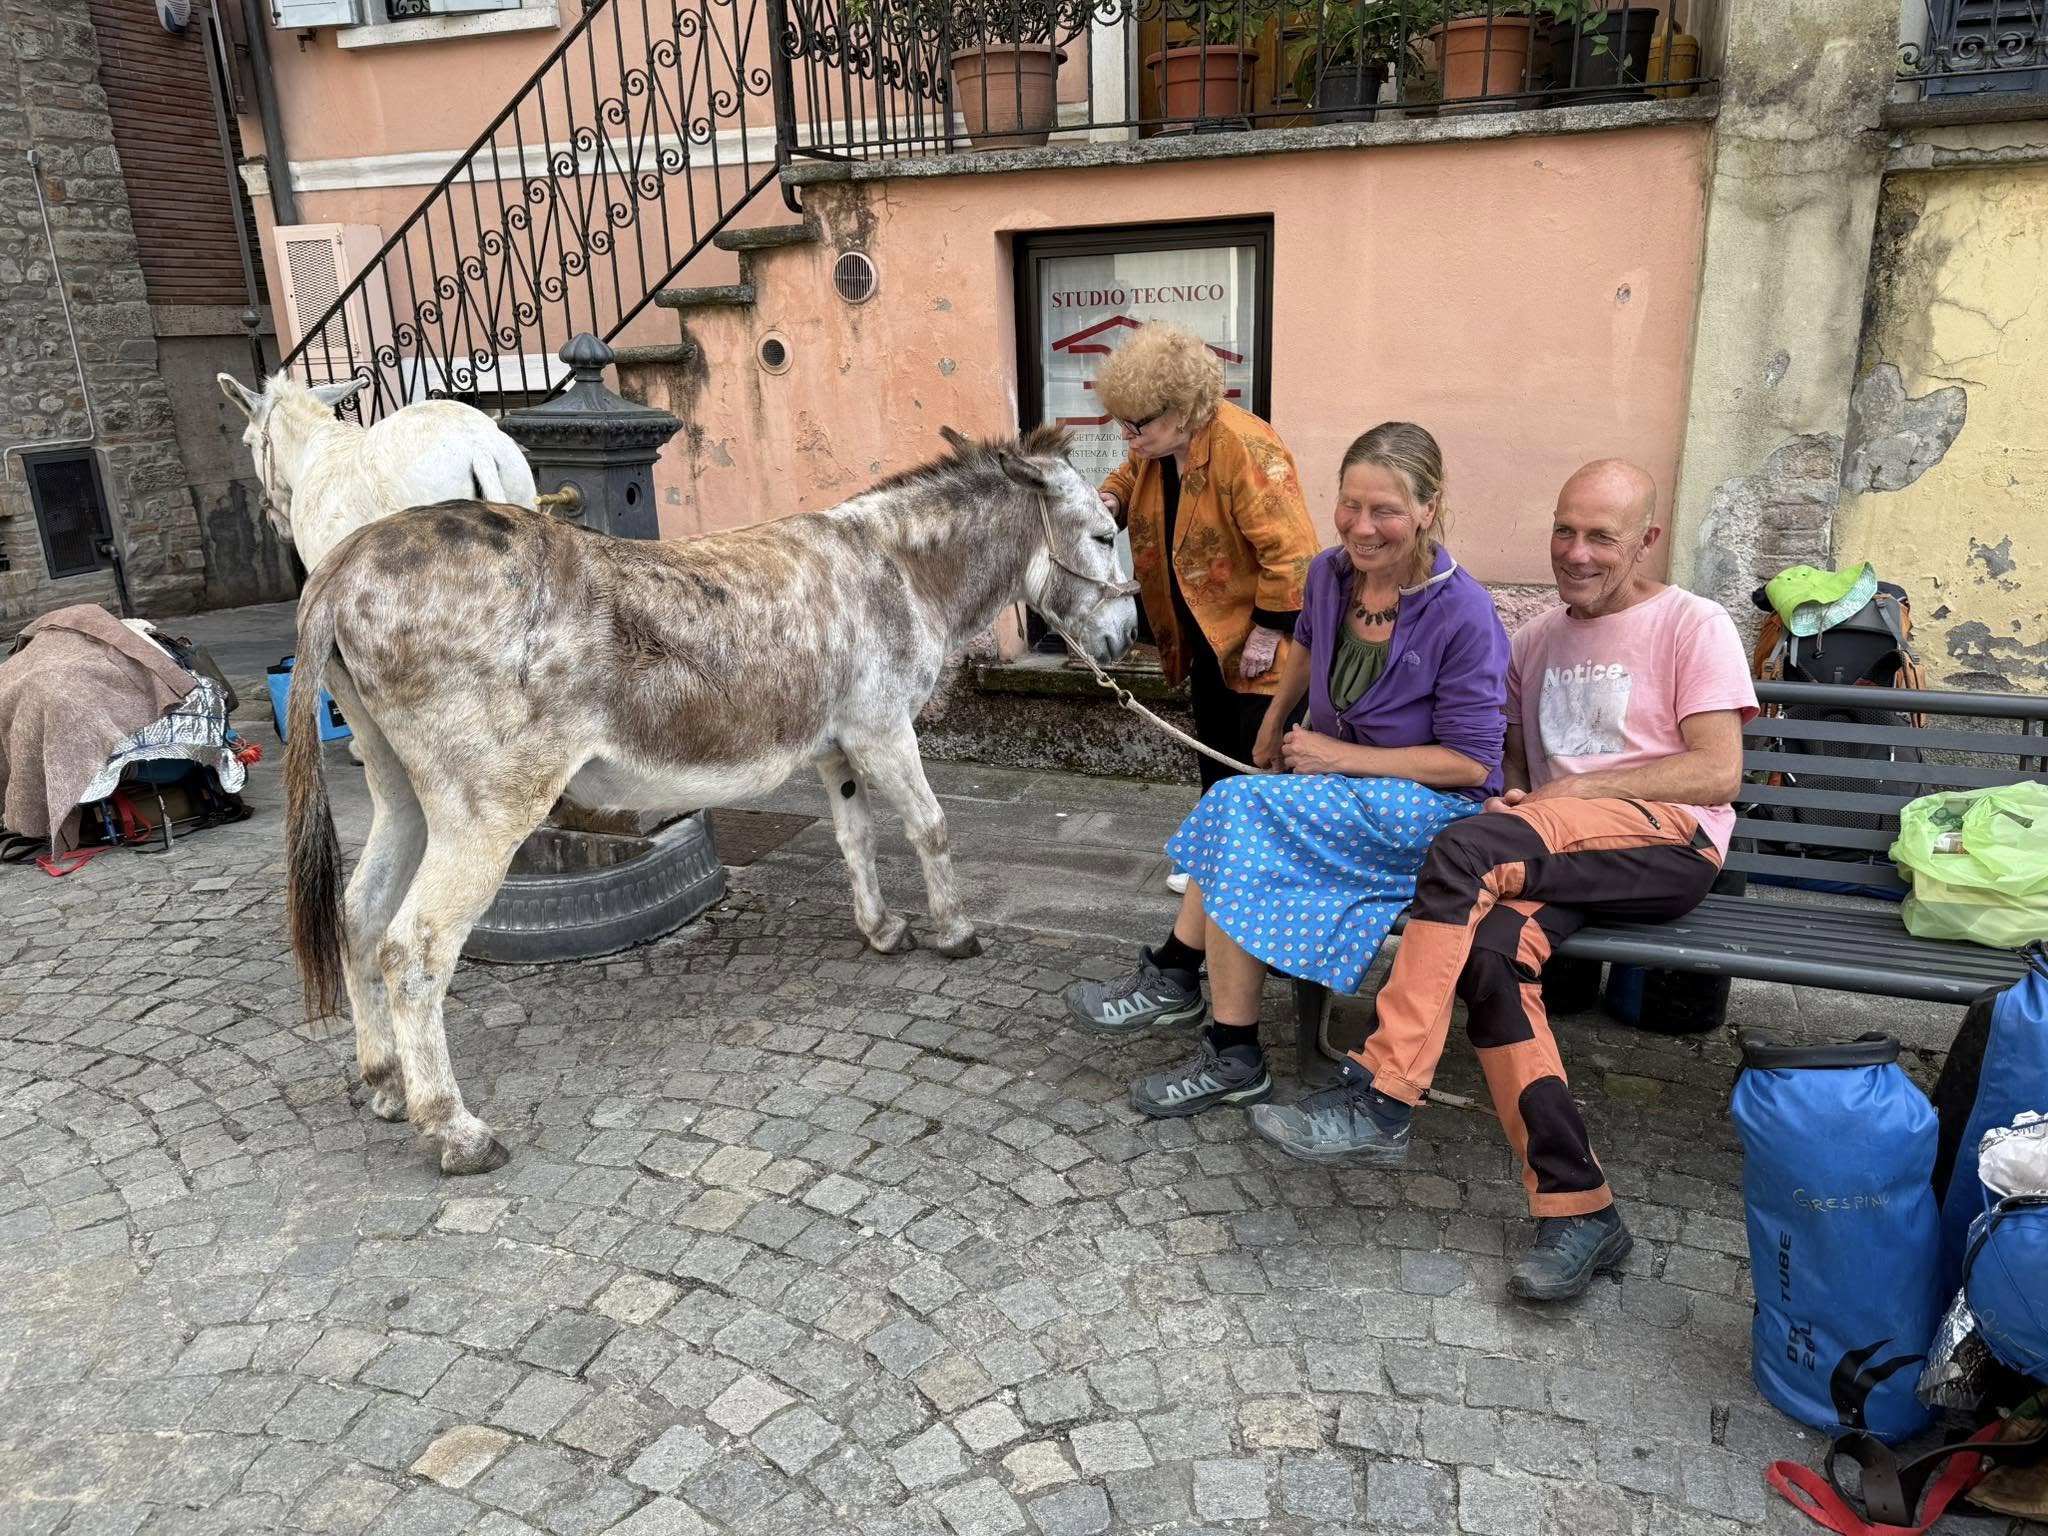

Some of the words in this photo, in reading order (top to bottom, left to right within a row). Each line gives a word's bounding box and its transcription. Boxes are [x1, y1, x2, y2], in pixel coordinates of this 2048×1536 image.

[1052, 289, 1126, 308] STUDIO
[1130, 284, 1224, 304] TECNICO
[1072, 433, 1122, 442] GETTAZION
[1545, 659, 1624, 685] Notice
[1778, 1230, 1792, 1303] TUBE
